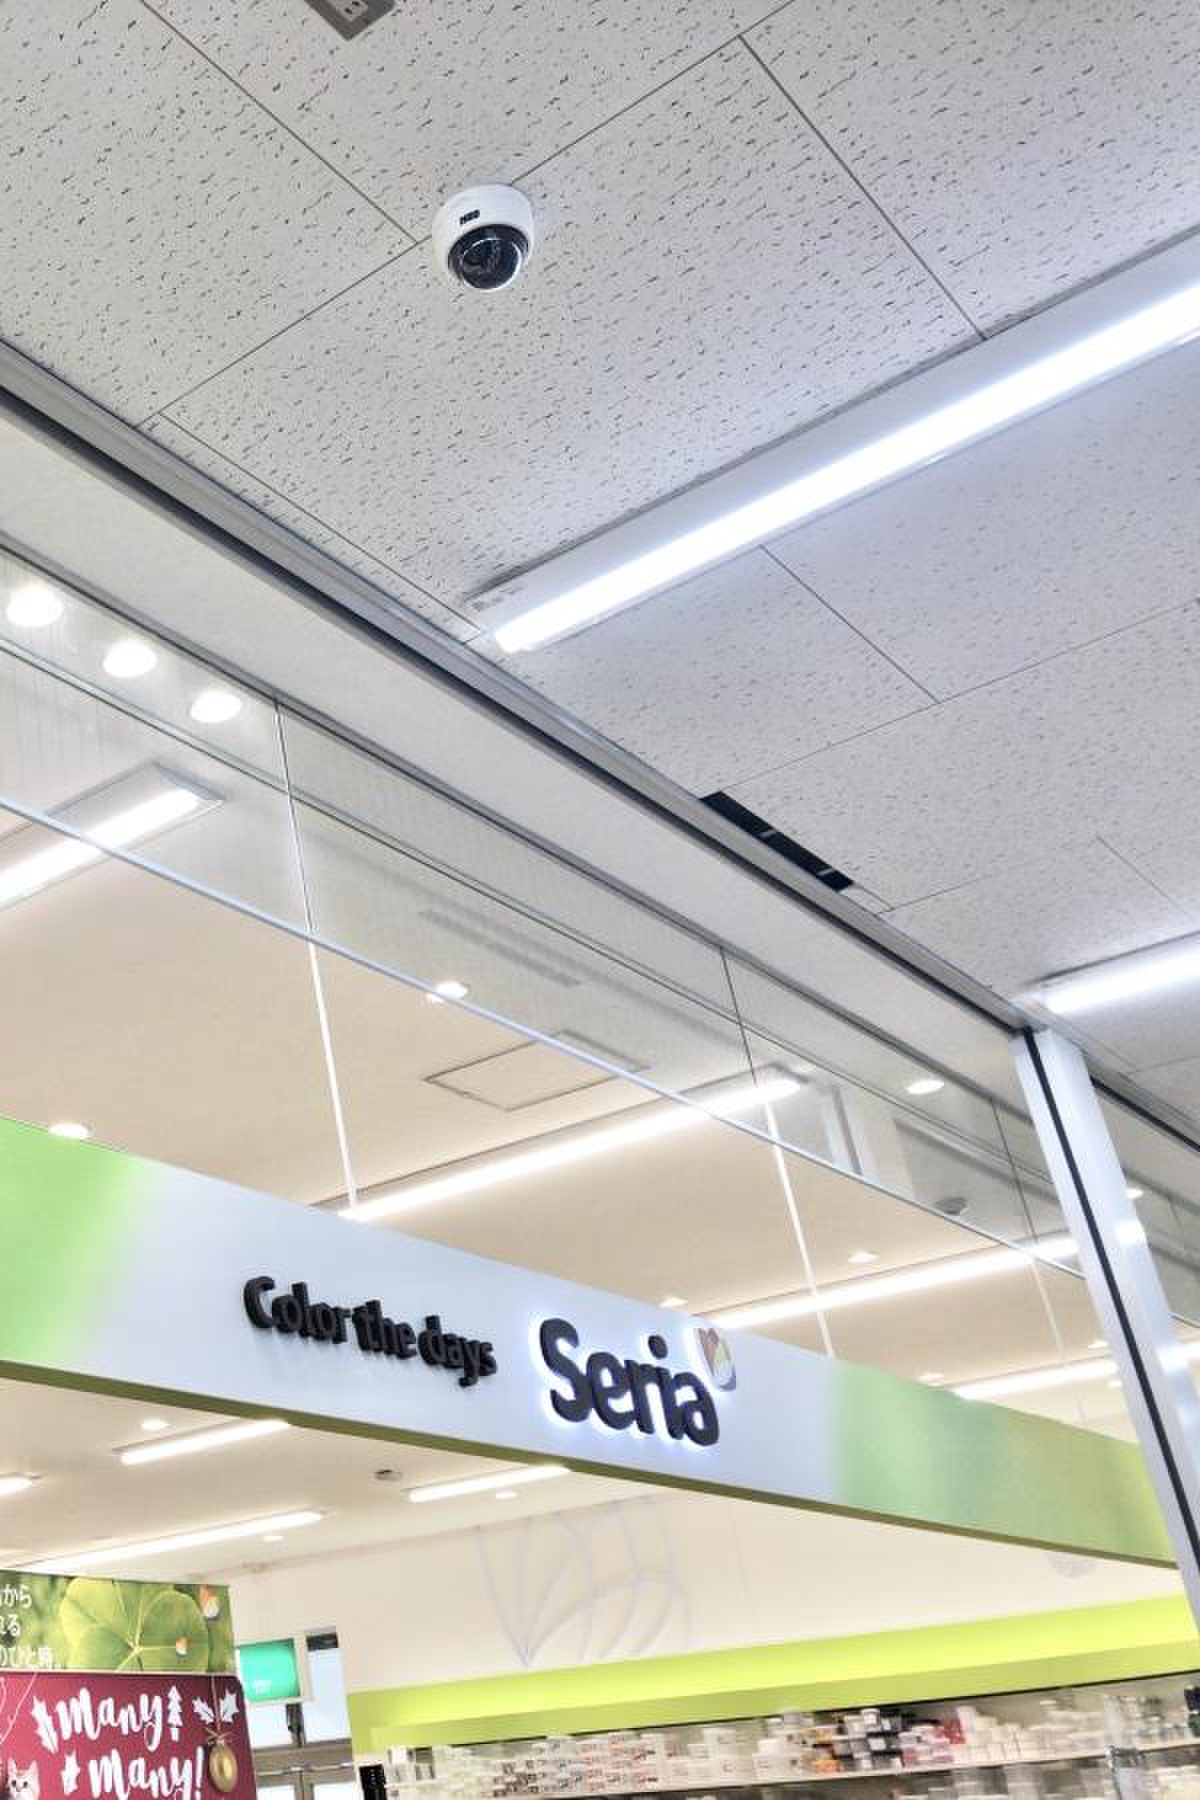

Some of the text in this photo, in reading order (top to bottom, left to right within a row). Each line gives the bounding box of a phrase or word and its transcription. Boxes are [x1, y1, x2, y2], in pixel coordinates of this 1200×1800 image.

[243, 1276, 497, 1387] Color the days
[540, 1318, 720, 1446] Seria
